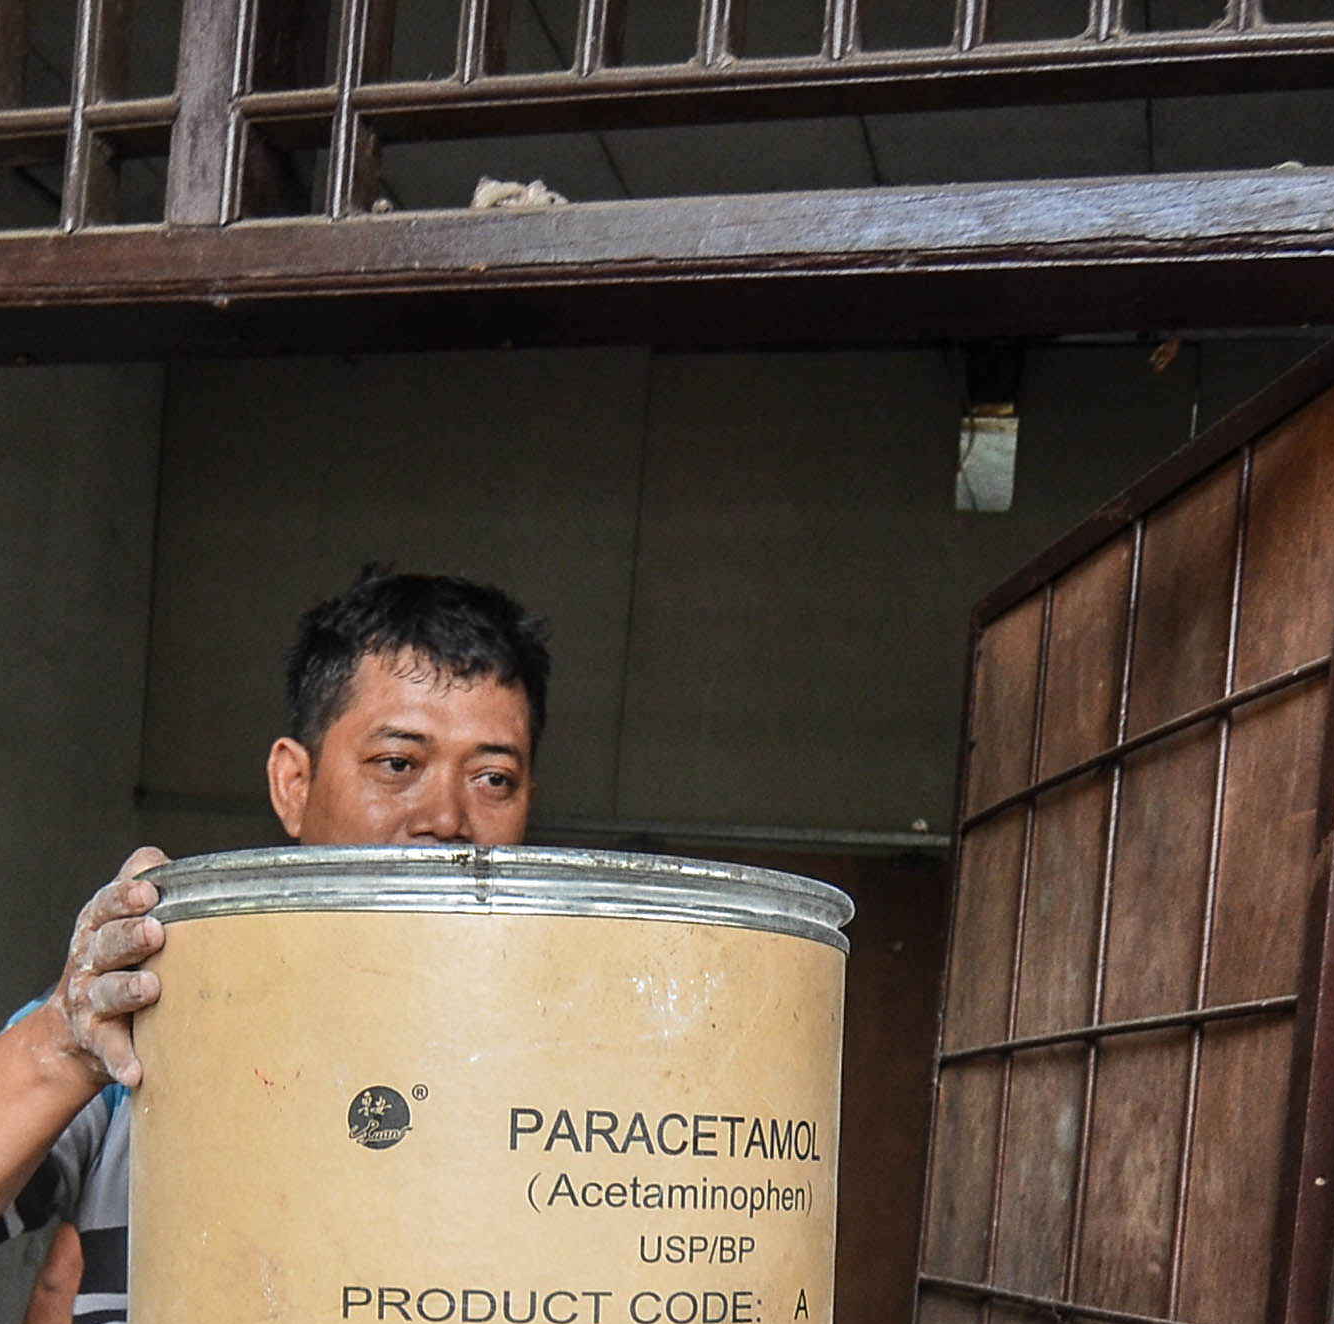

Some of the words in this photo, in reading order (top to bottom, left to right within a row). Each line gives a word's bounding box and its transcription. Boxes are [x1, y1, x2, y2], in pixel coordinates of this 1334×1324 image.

[509, 1107, 821, 1162] PARACETAMOL
[527, 1171, 814, 1220] (Acetaminophen)
[640, 1234, 756, 1265] USP/BP
[793, 1288, 809, 1321] A
